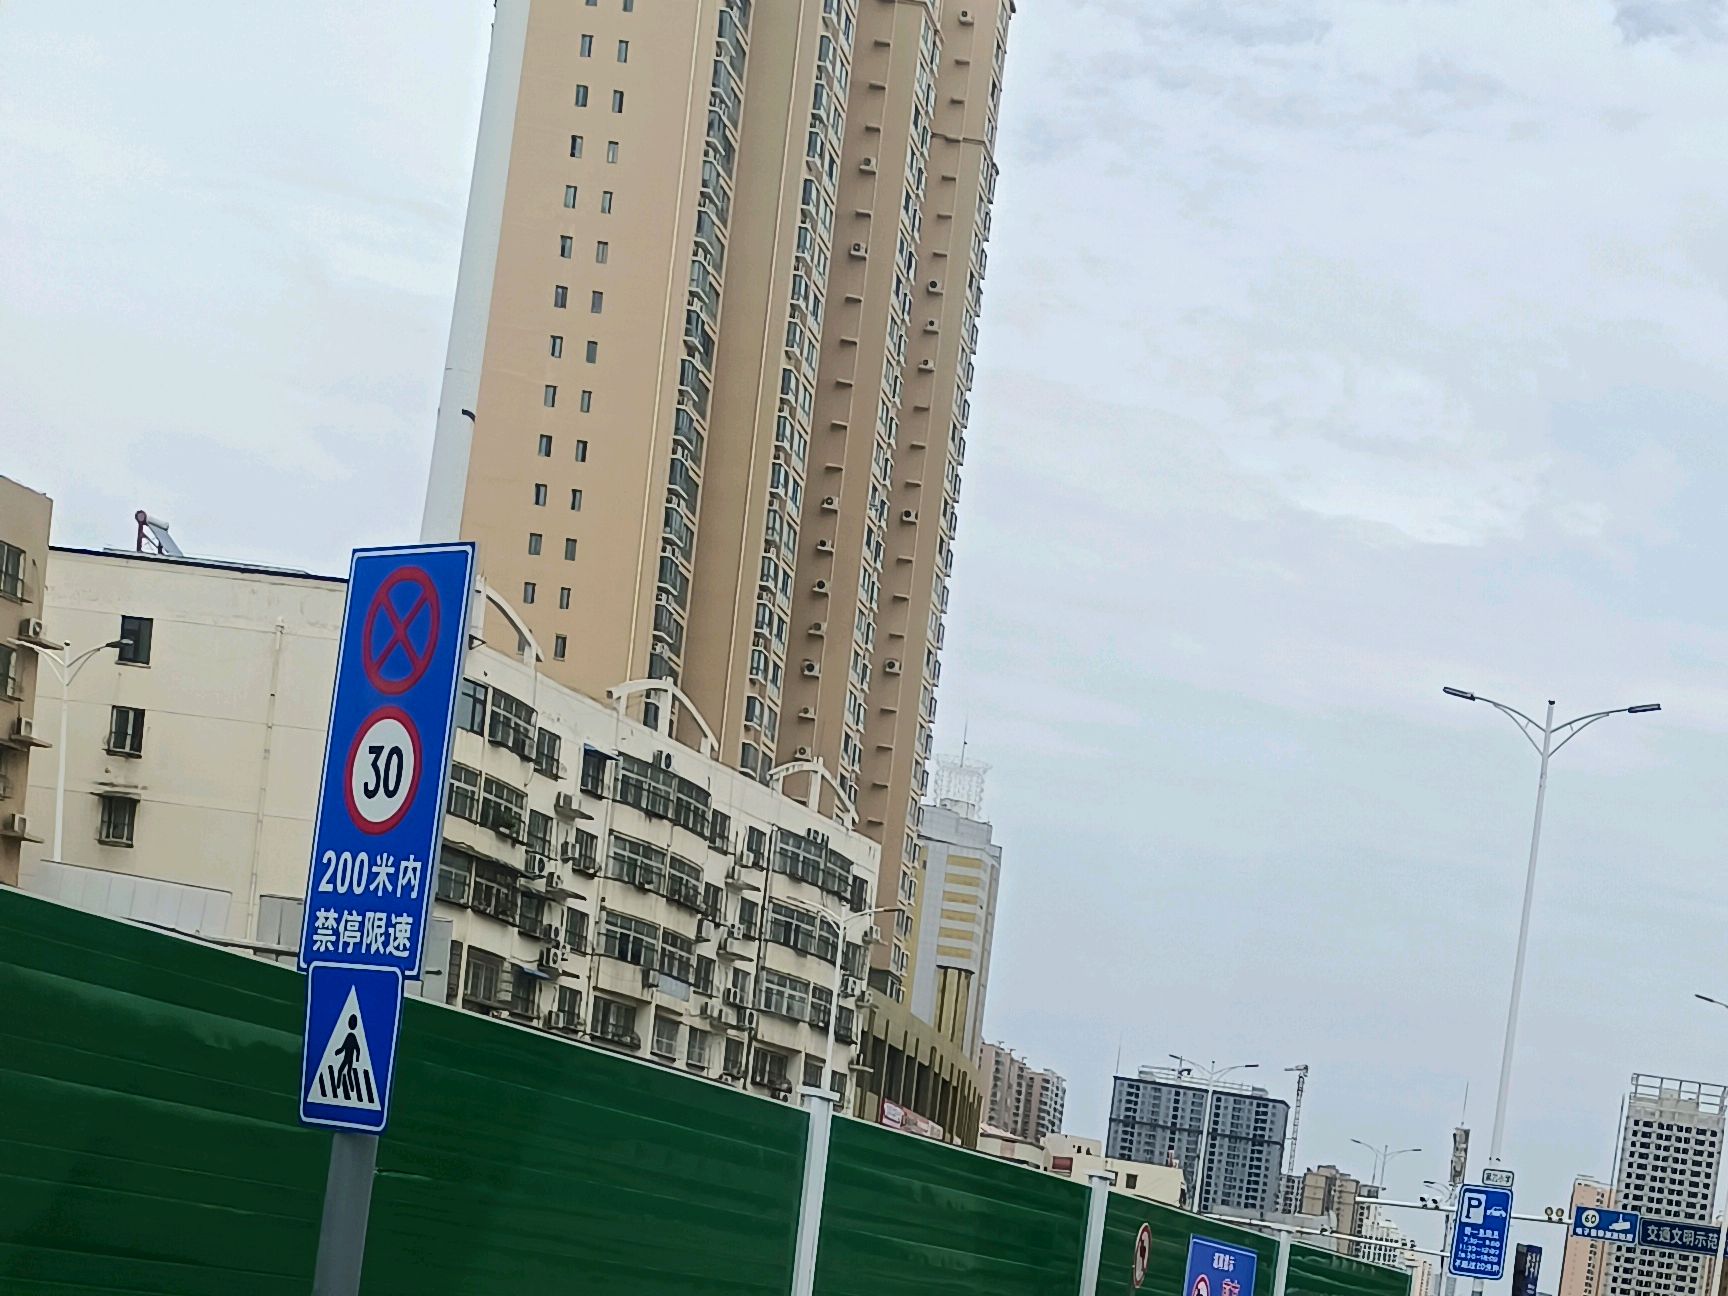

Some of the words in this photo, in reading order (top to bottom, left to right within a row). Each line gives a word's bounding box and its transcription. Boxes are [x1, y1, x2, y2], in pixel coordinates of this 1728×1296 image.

[364, 745, 404, 799] 30
[318, 850, 422, 899] 200米内
[312, 907, 414, 958] 禁停限速
[1465, 1197, 1482, 1219] P
[1584, 1213, 1597, 1224] 60
